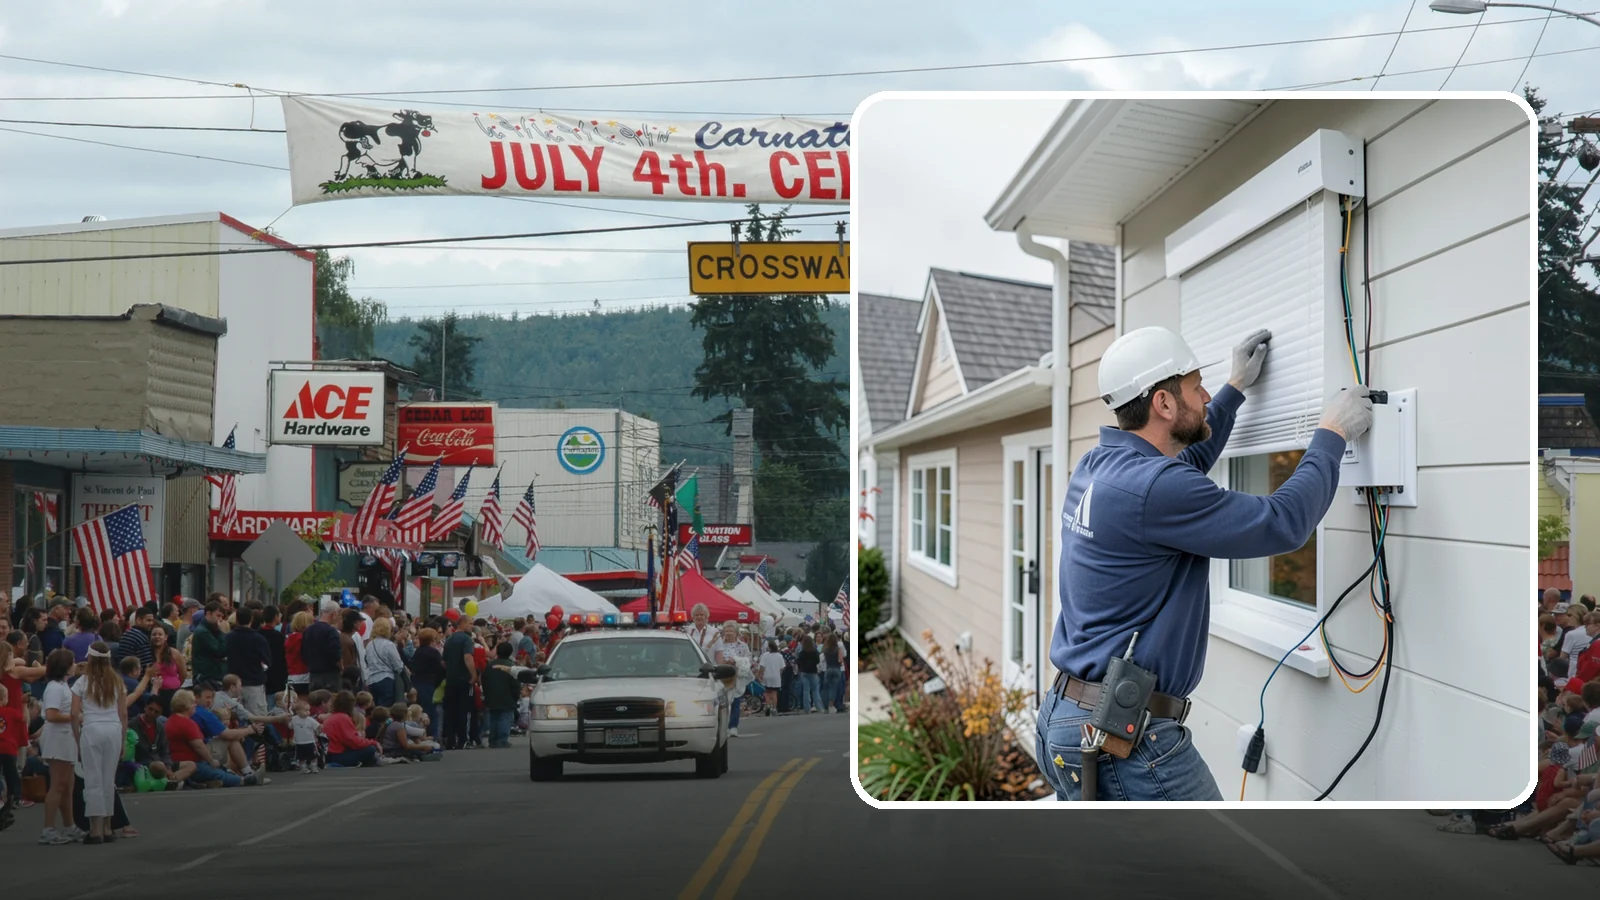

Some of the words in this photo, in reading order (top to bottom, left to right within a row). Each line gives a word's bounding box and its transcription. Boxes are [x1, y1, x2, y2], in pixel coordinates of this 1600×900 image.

[695, 121, 850, 150] Carnat
[481, 141, 605, 192] JULY
[632, 150, 746, 198] 4th.
[697, 254, 850, 280] CROSSWA
[283, 380, 373, 419] ACE
[405, 409, 453, 422] CEDAR
[283, 421, 370, 436] Hardware
[416, 428, 477, 447] Coca-Cola
[83, 486, 93, 494] St.
[96, 485, 124, 495] Vincent
[126, 485, 134, 494] de
[138, 486, 155, 495] Paul
[81, 503, 154, 522] THRT
[688, 526, 741, 535] CRNATION
[699, 535, 730, 544] GLASS
